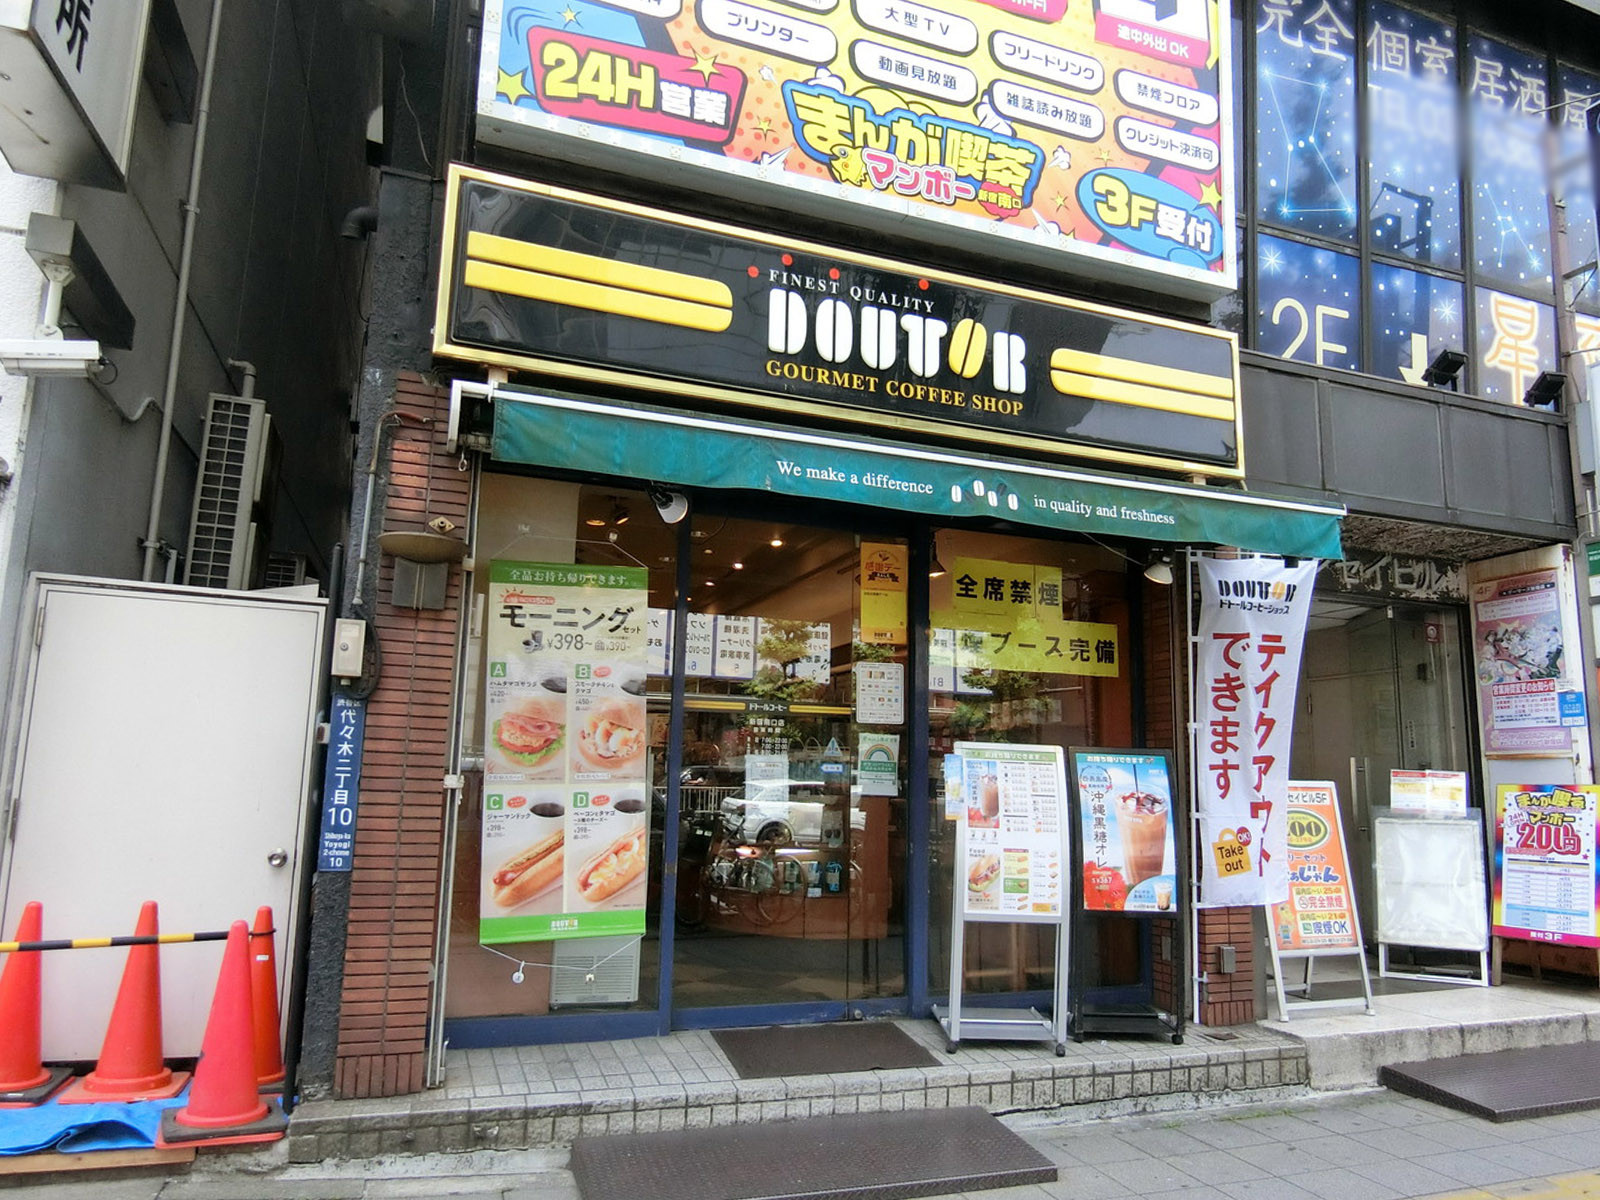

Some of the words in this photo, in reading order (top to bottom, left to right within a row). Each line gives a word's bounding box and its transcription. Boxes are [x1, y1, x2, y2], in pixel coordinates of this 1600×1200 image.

[726, 11, 810, 43] プリンター
[885, 6, 951, 36] 大型TV
[1117, 23, 1189, 59] 途中外出OK
[878, 55, 958, 91] 動画見放題
[1004, 42, 1096, 80] フリードリンク
[542, 41, 729, 127] 24H営業
[1136, 81, 1201, 111] 禁煙フロア
[1006, 92, 1093, 129] 雑誌読み放題
[791, 90, 1036, 197] まんが喫茶
[1125, 127, 1214, 163] クレジット決済可
[865, 152, 974, 201] マンボー
[1094, 174, 1214, 252] 3F受付
[769, 268, 840, 294] FINEST
[850, 286, 935, 313] QUALITY
[768, 287, 1027, 394] DOUTOR
[1272, 297, 1349, 365] 2F
[766, 359, 878, 393] GOURMET
[885, 379, 966, 407] COFFEE
[971, 394, 1024, 416] SHOP
[776, 460, 802, 477] We
[805, 466, 846, 483] make
[850, 473, 859, 484] a
[862, 471, 934, 495] difference
[1033, 494, 1047, 509] in
[1050, 498, 1092, 517] quality
[1096, 503, 1118, 519] and
[1120, 504, 1175, 525] freshness
[955, 573, 1060, 607] 全席禁煙
[1217, 579, 1297, 602] DOUTOR
[499, 604, 635, 633] モーニング
[493, 664, 504, 676] A
[579, 666, 588, 678] B
[1208, 632, 1251, 800] できます
[334, 709, 357, 806] 代々木二丁目
[328, 807, 353, 826] 10
[490, 796, 500, 808] C
[576, 794, 585, 807] D
[324, 840, 351, 849] Yoyogi
[1090, 790, 1108, 868] 沖縄黒糖オレ
[323, 848, 350, 856] 2-chome
[329, 857, 343, 867] 10
[1218, 845, 1244, 859] Take
[1224, 859, 1244, 872] out
